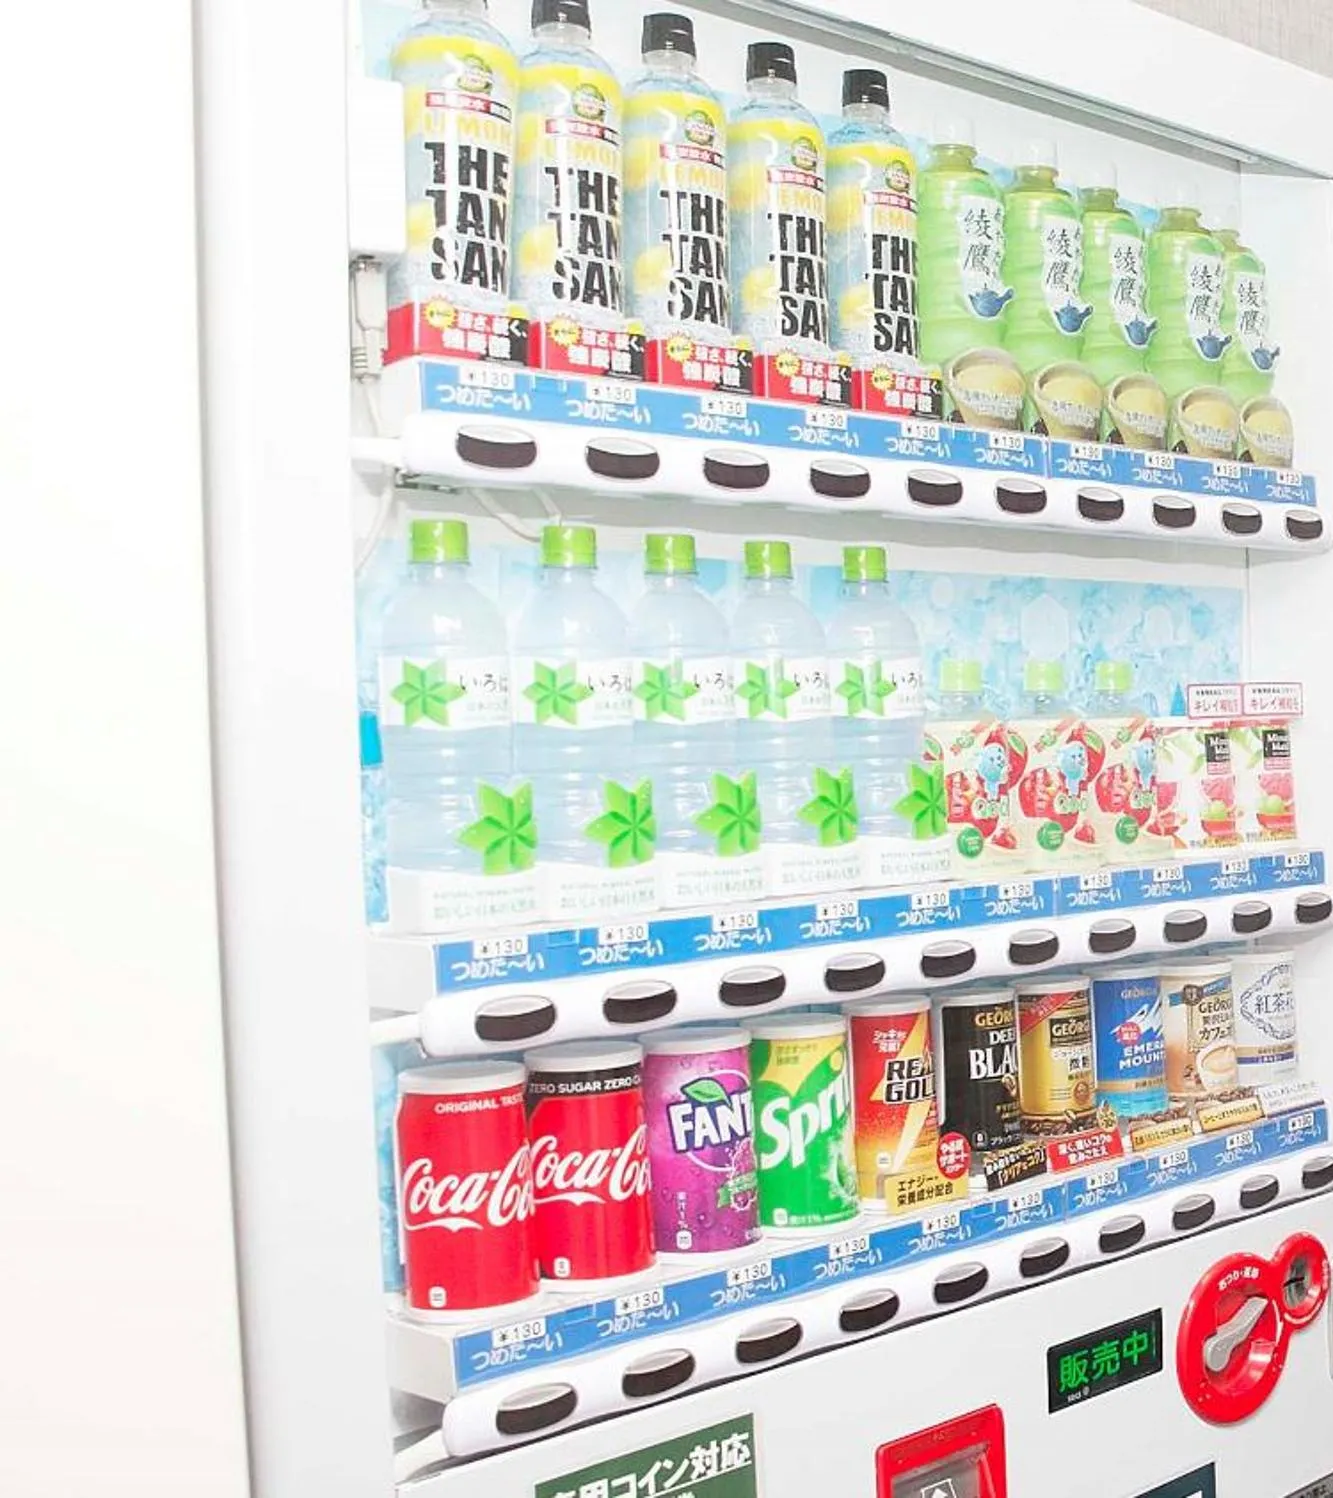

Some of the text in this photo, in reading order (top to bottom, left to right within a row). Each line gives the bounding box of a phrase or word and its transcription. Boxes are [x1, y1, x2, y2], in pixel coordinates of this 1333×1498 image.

[425, 142, 509, 197] THE
[425, 189, 509, 242] TAN
[558, 1080, 603, 1093] SUGAR
[434, 1098, 499, 1115] ORIGINAL
[897, 1182, 954, 1208] 栄養成分配合
[1058, 1329, 1149, 1395] 販売中
